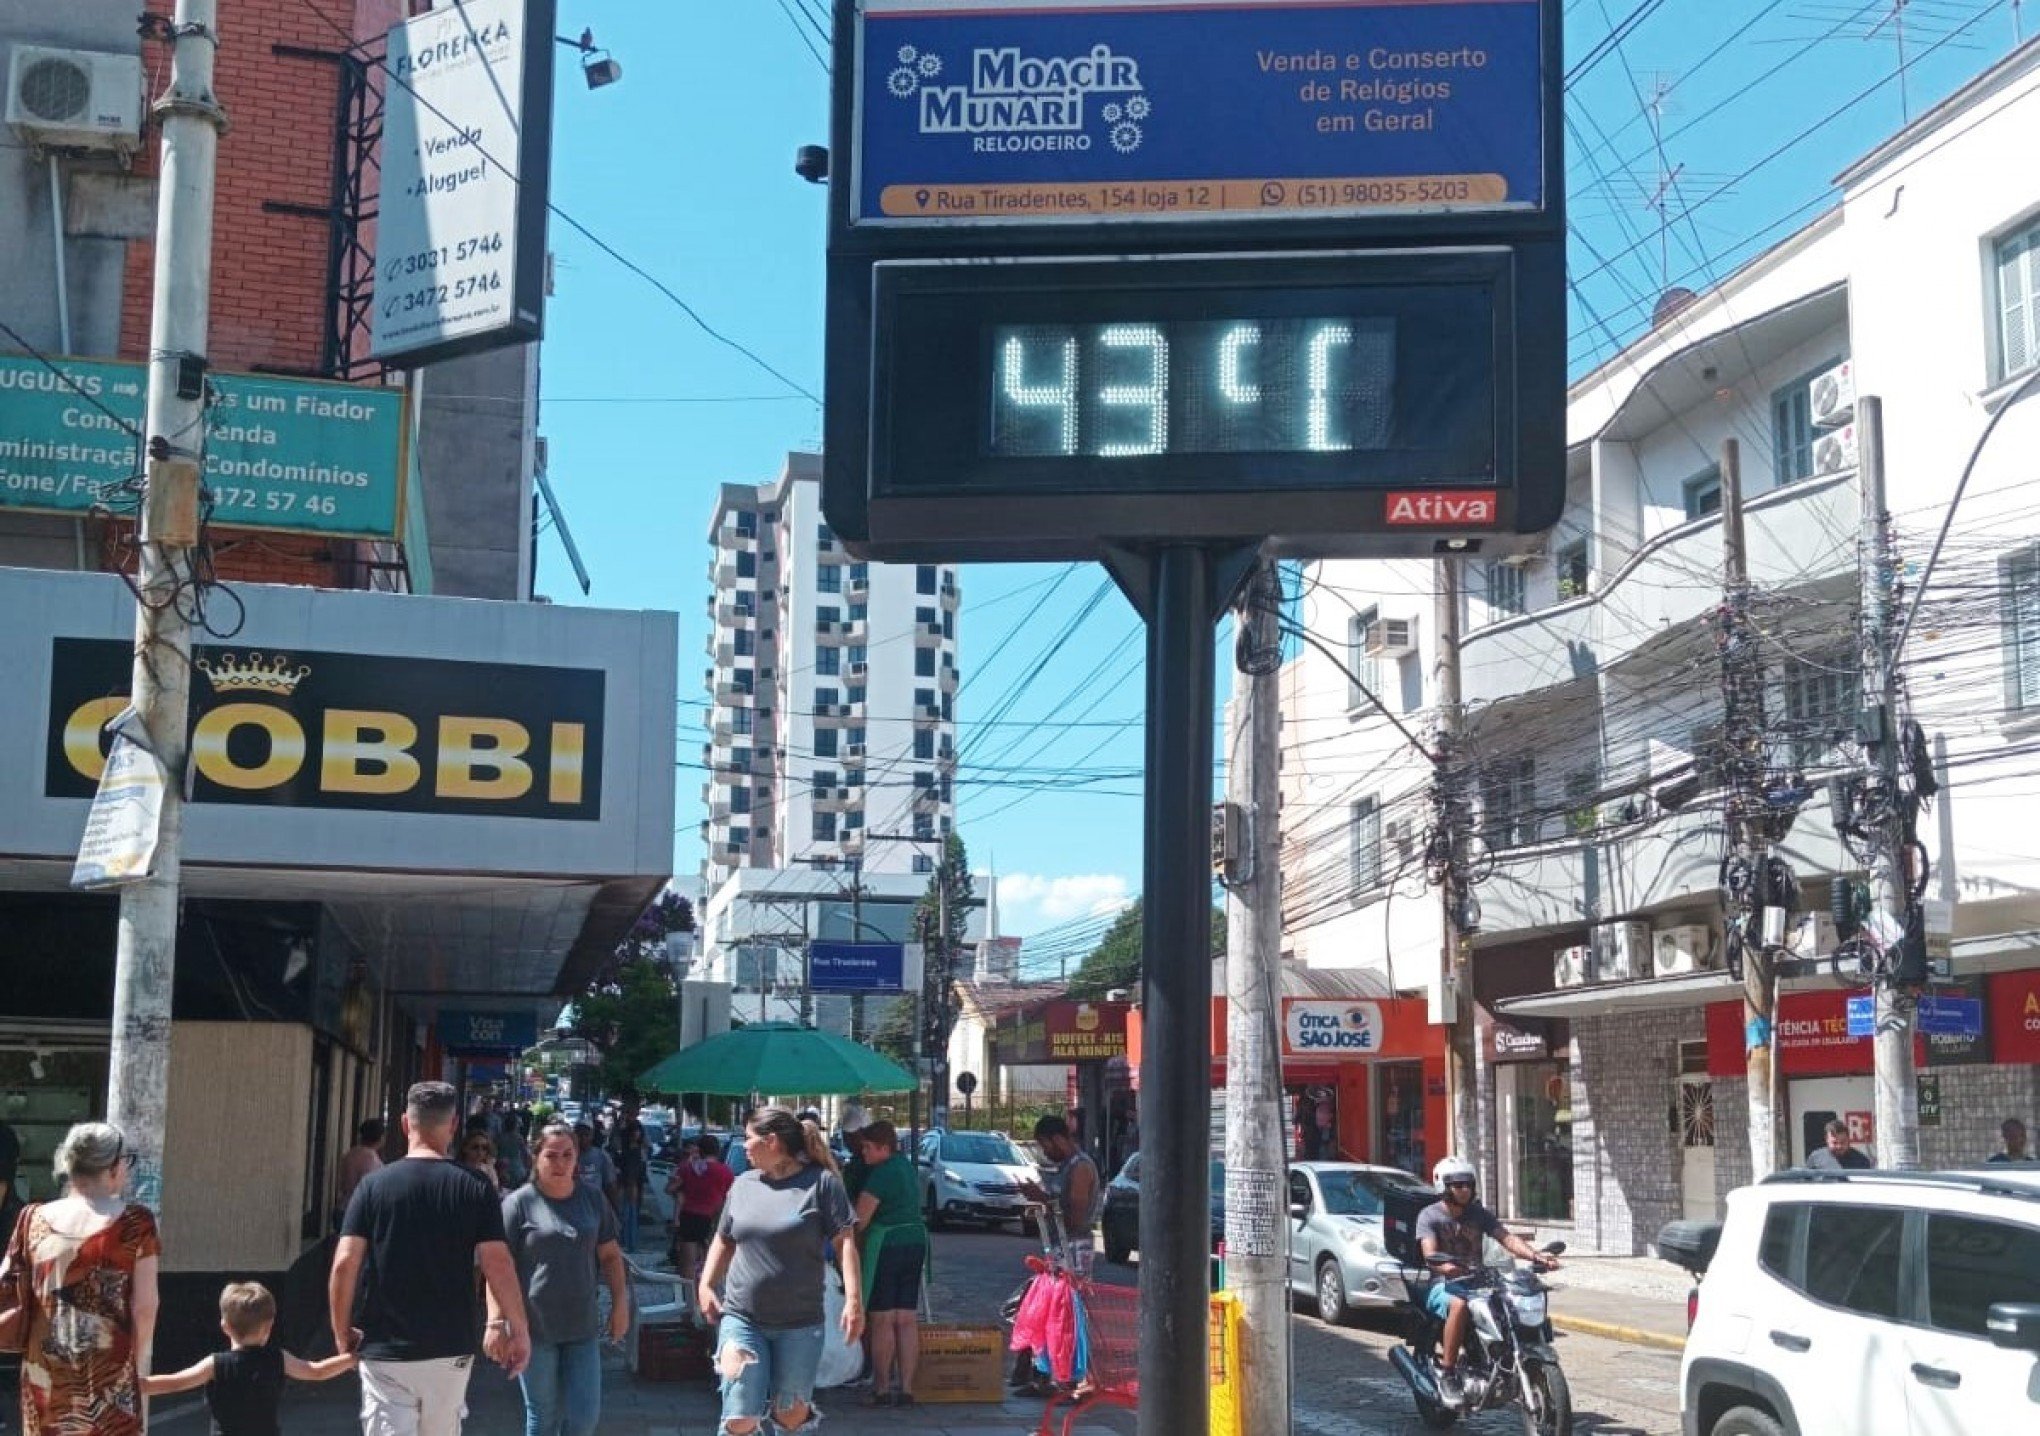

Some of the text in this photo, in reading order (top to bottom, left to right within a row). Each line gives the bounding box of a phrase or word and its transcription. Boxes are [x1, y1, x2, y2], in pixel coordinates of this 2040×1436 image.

[1257, 46, 1487, 71] Venda e Conserto
[1301, 77, 1451, 104] de Relógios
[1317, 108, 1433, 132] em Geral
[425, 126, 482, 156] Venda
[974, 135, 1091, 151] RELOJOEIRO
[415, 158, 486, 198] Aluguel
[937, 186, 1210, 211] Rua Tiradentes, 154 loja 12
[1298, 181, 1469, 207] (51) 98035-5203
[405, 232, 503, 274] 3031 5746
[404, 271, 500, 312] 3472 5746
[247, 394, 285, 413] um
[296, 396, 376, 421] Fiador
[62, 407, 139, 436] Comp
[0, 438, 369, 488] ministraçã Condomínios
[212, 486, 256, 509] 472
[266, 491, 297, 511] 57
[305, 494, 336, 516] 46
[1390, 495, 1487, 521] Ativa
[1299, 1012, 1340, 1029] ÓTICA
[1778, 1014, 1847, 1036] TÊNCIA TÉC
[1300, 1029, 1371, 1048] SÃO JOSÉ
